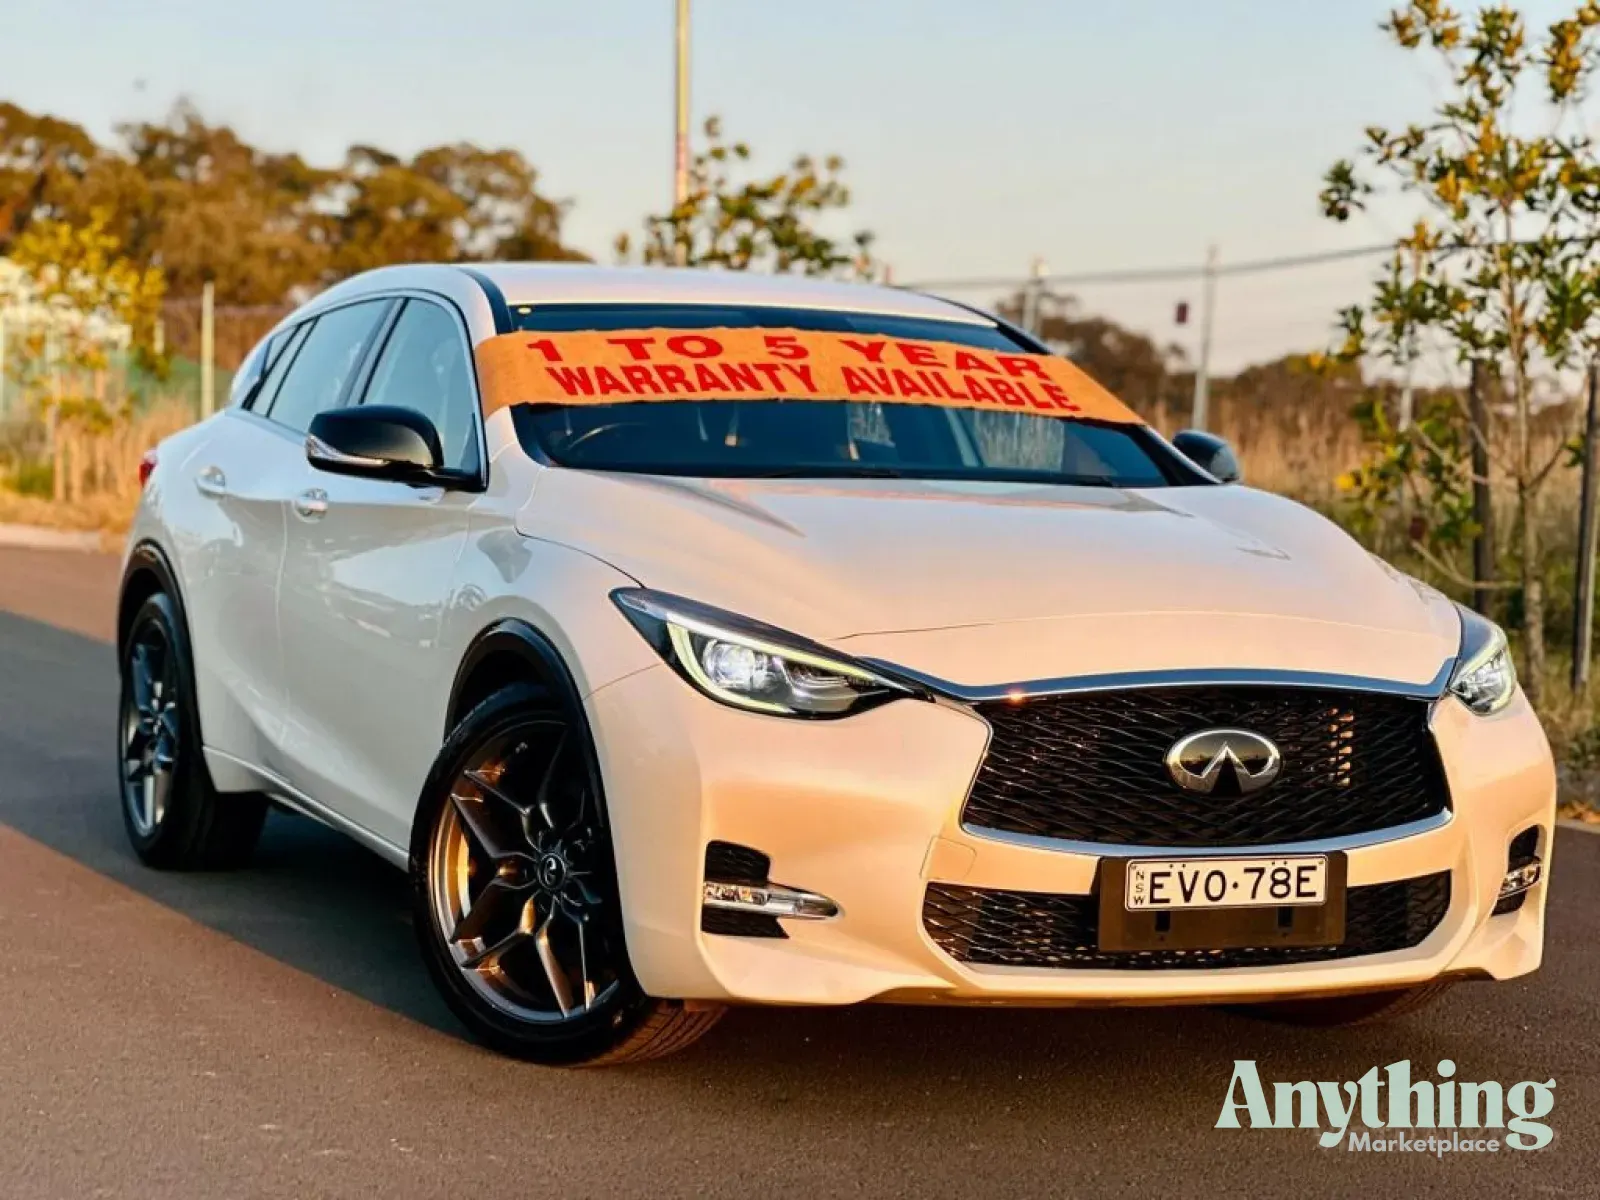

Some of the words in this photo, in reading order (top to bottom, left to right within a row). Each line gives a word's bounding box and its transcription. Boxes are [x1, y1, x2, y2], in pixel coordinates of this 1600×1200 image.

[526, 339, 564, 362] 1
[607, 335, 724, 361] TO
[763, 335, 810, 360] 5
[839, 339, 1052, 382] YEAR
[545, 362, 818, 396] WARRANTY
[841, 366, 1082, 412] AVAILABLE
